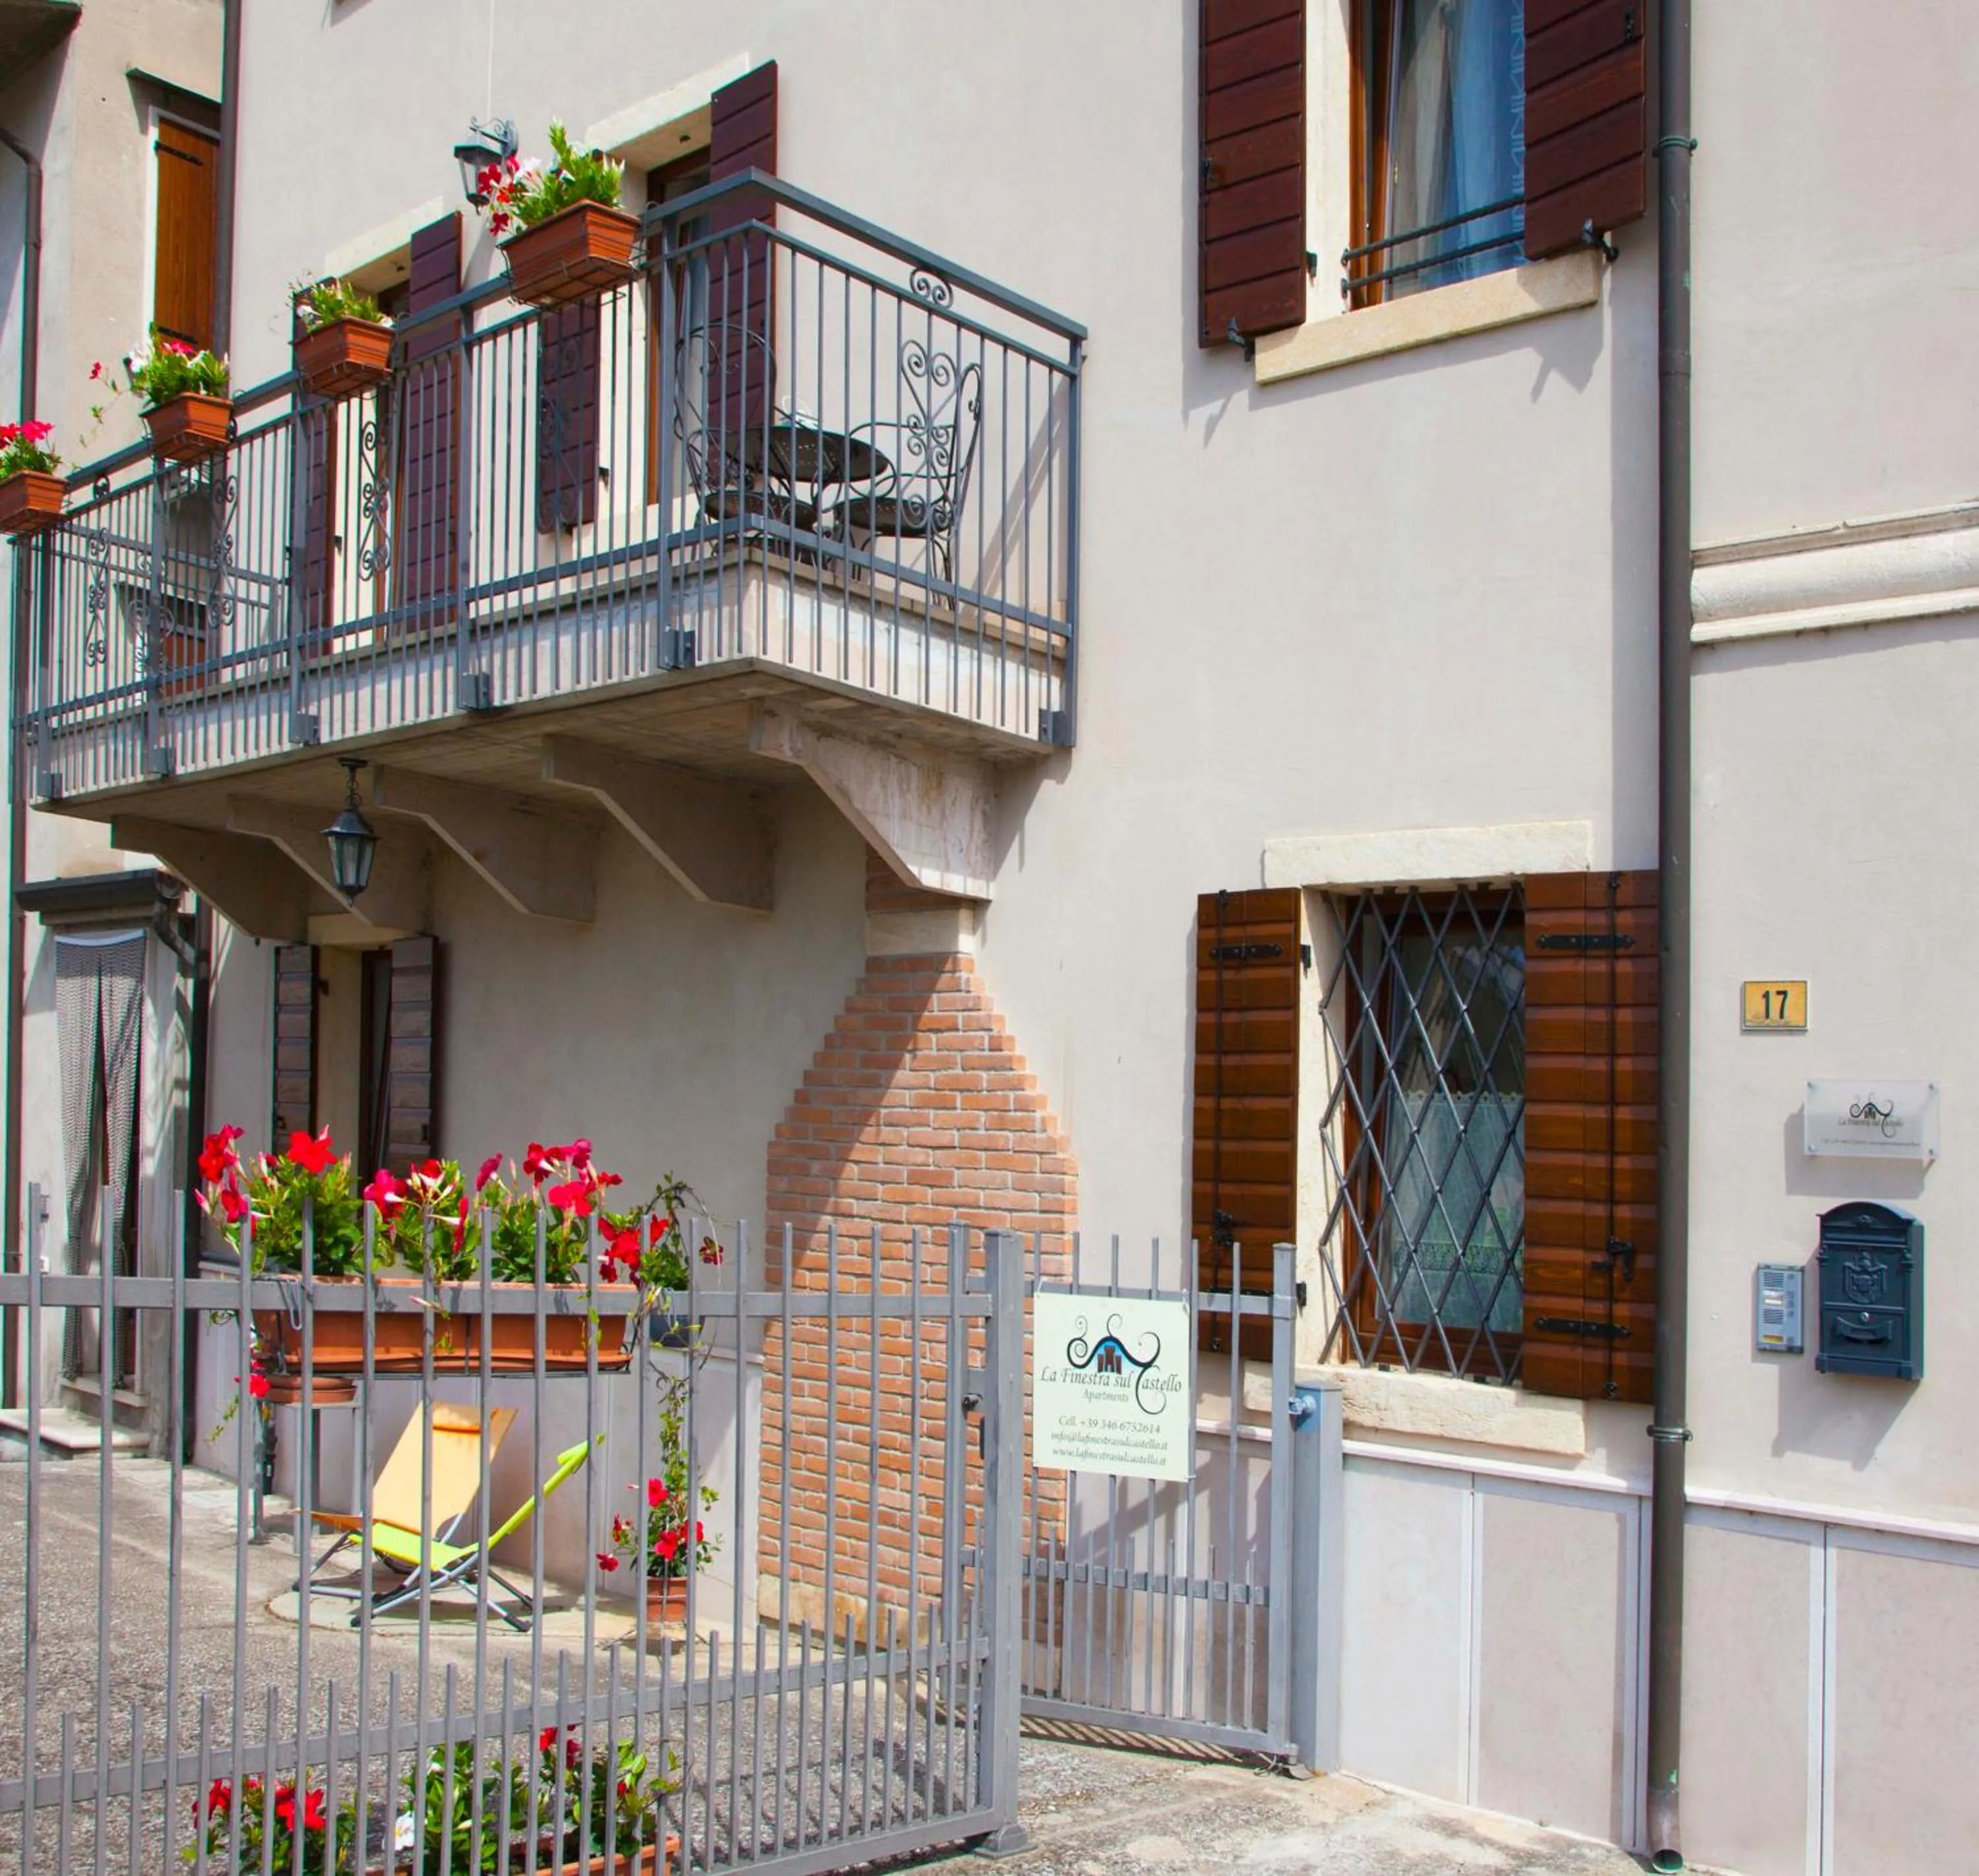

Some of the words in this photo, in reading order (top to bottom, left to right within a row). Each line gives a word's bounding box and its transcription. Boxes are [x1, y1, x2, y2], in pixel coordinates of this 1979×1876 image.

[1762, 990, 1788, 1020] 17
[1041, 1365, 1057, 1382] La
[1061, 1367, 1110, 1387] Finestra
[1114, 1371, 1134, 1389] sul
[1082, 1389, 1129, 1403] Apartments
[1080, 1418, 1098, 1428] +39
[1100, 1419, 1117, 1430] 346
